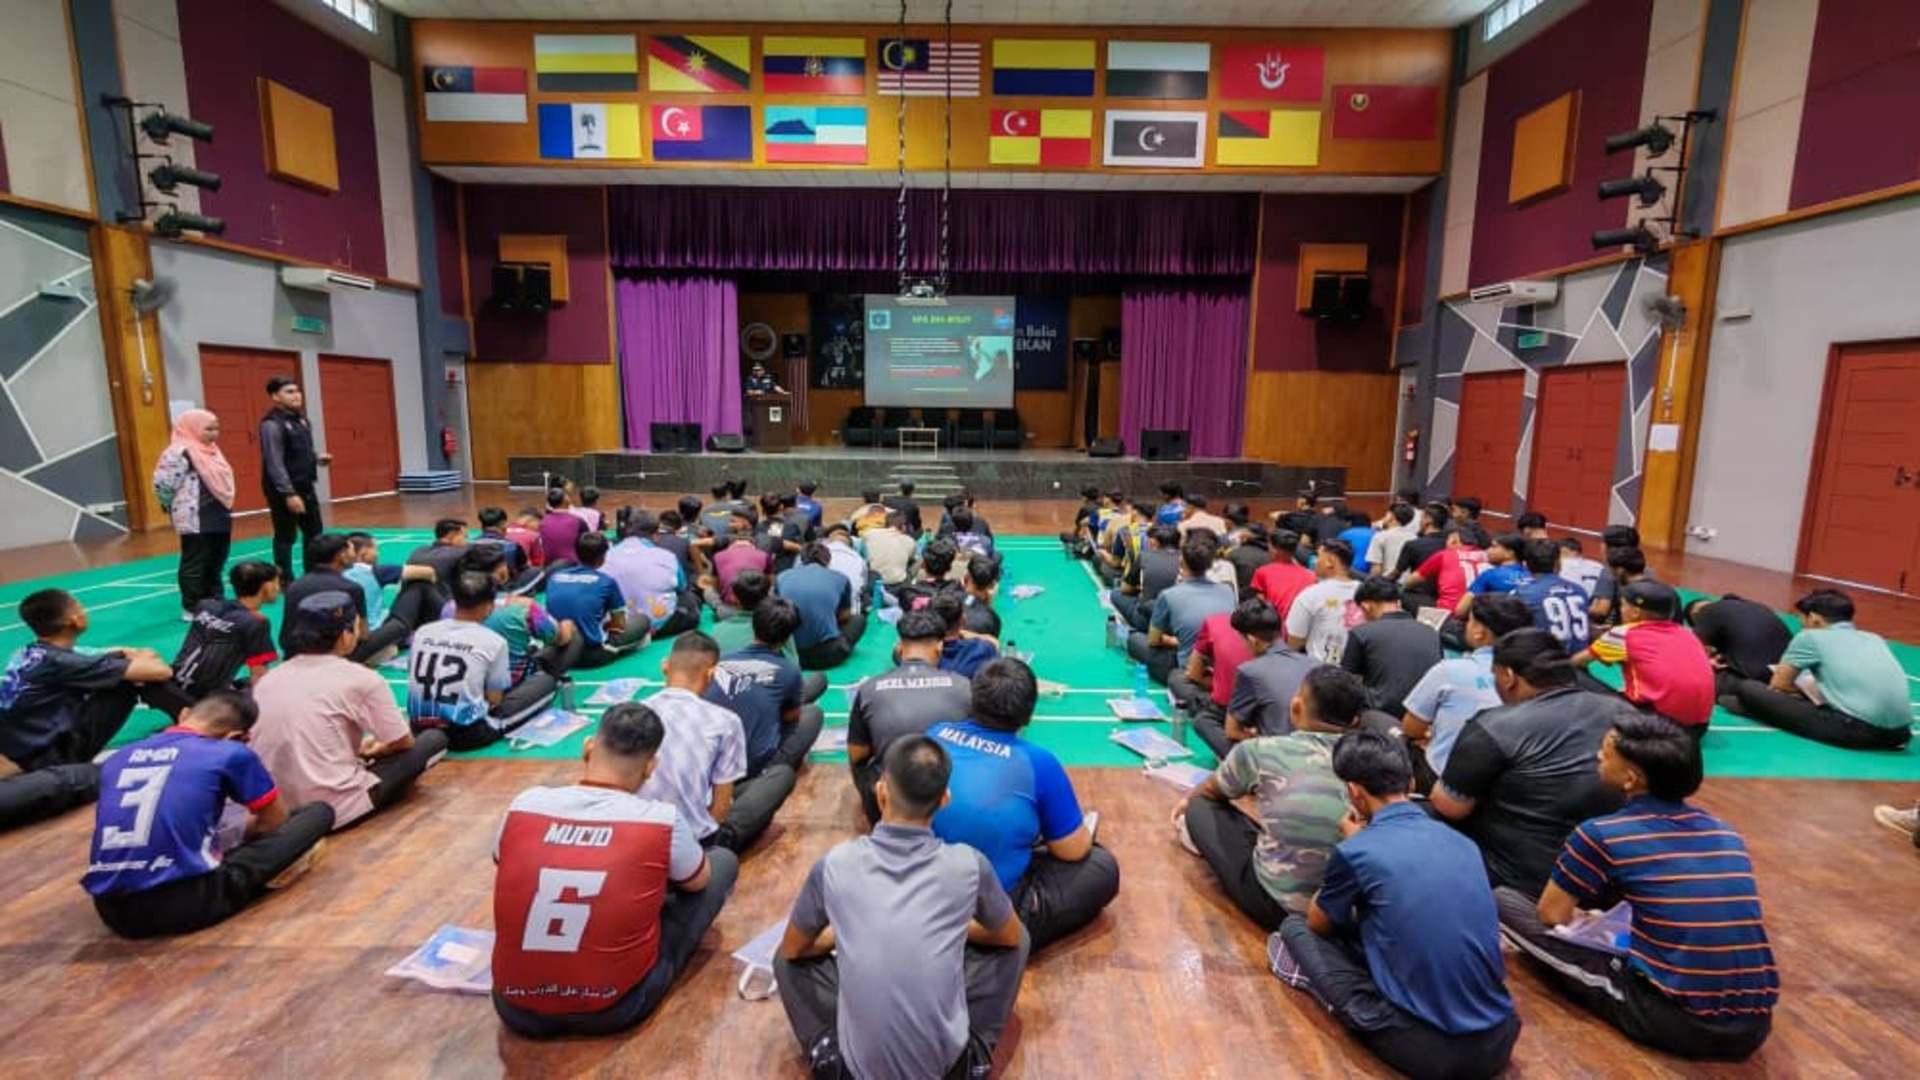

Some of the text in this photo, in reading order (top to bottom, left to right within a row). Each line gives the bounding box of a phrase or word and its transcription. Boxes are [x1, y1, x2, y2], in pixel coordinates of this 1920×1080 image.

[1543, 595, 1588, 640] 95
[414, 650, 468, 706] 42
[937, 726, 1011, 759] MALAYSIA
[101, 766, 173, 850] 3
[543, 822, 614, 847] MUCID
[521, 867, 608, 953] 6
